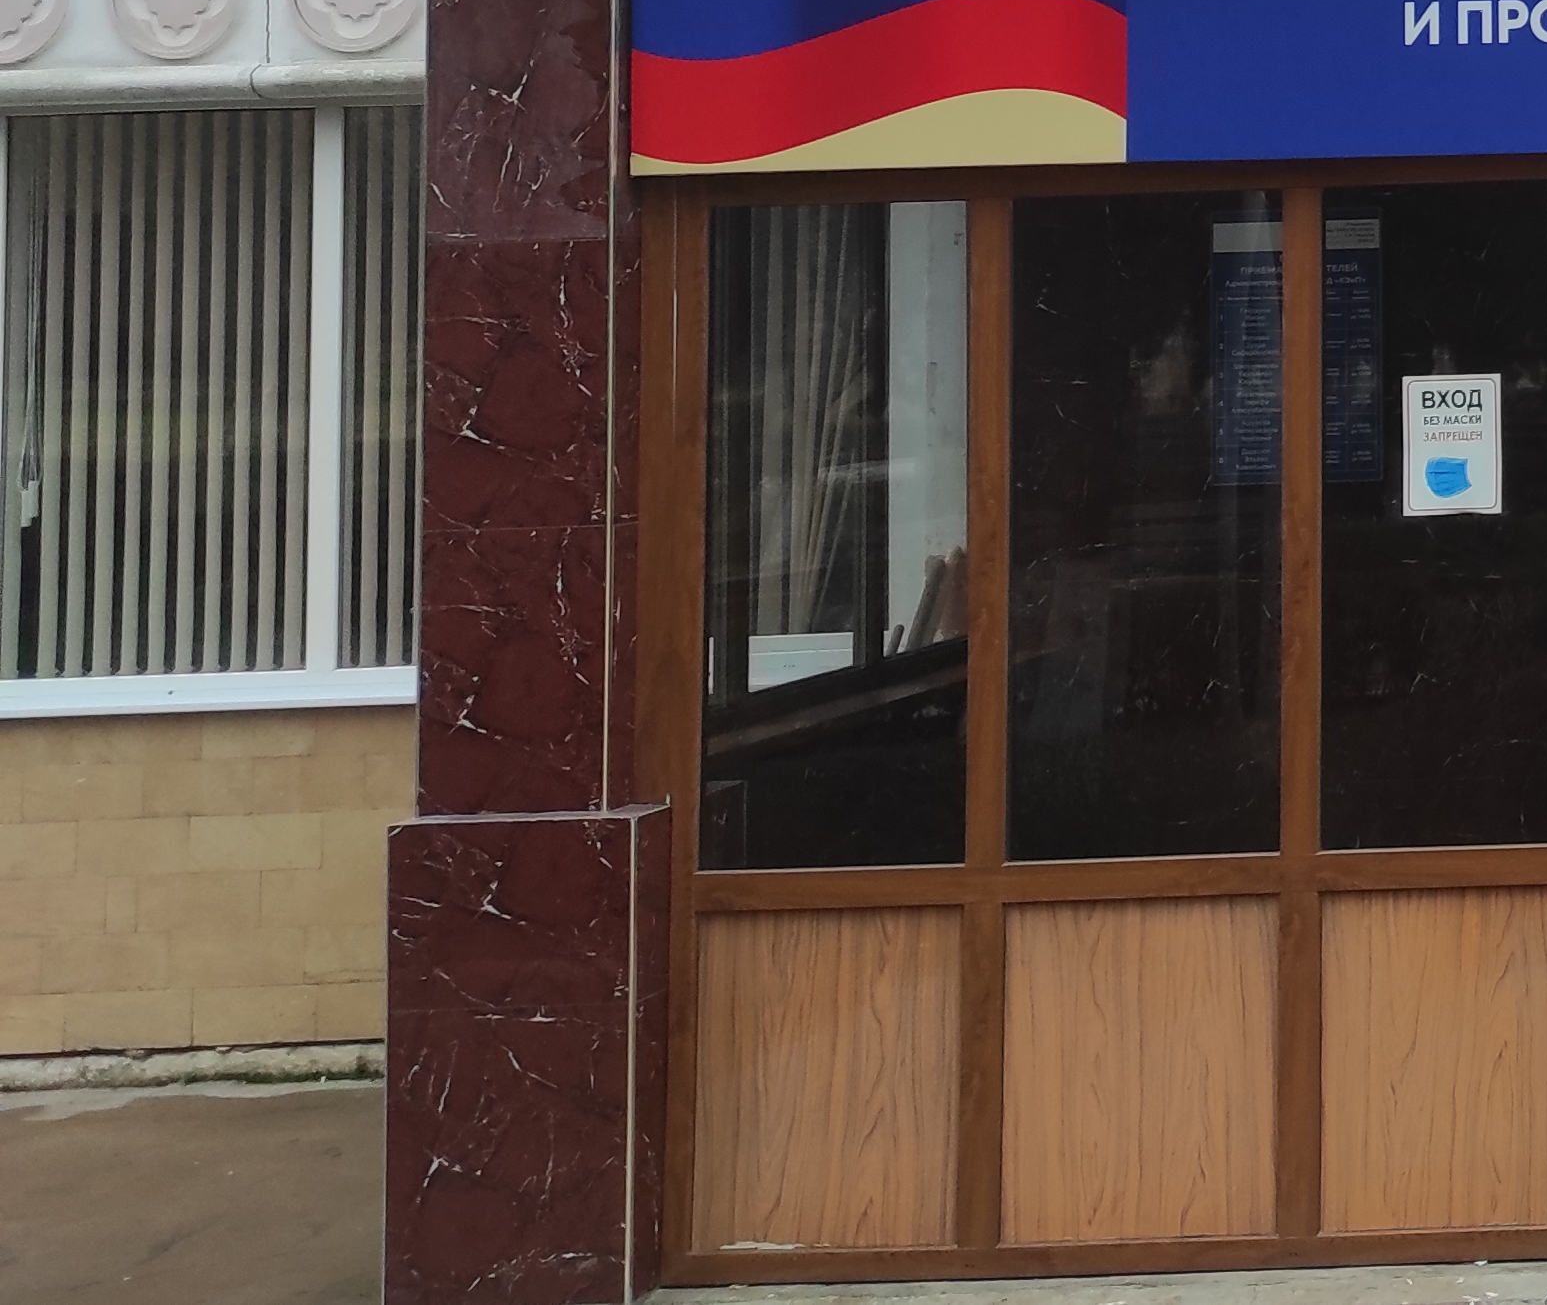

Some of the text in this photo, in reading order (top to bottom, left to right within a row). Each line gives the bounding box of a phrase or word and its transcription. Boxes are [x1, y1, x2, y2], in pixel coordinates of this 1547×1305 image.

[1403, 1, 1440, 46] И
[1421, 389, 1483, 412] ВХОД
[1423, 414, 1482, 426] БЕЗ МАСКИ
[1423, 430, 1483, 442] ЗАПРЕЩЕН
